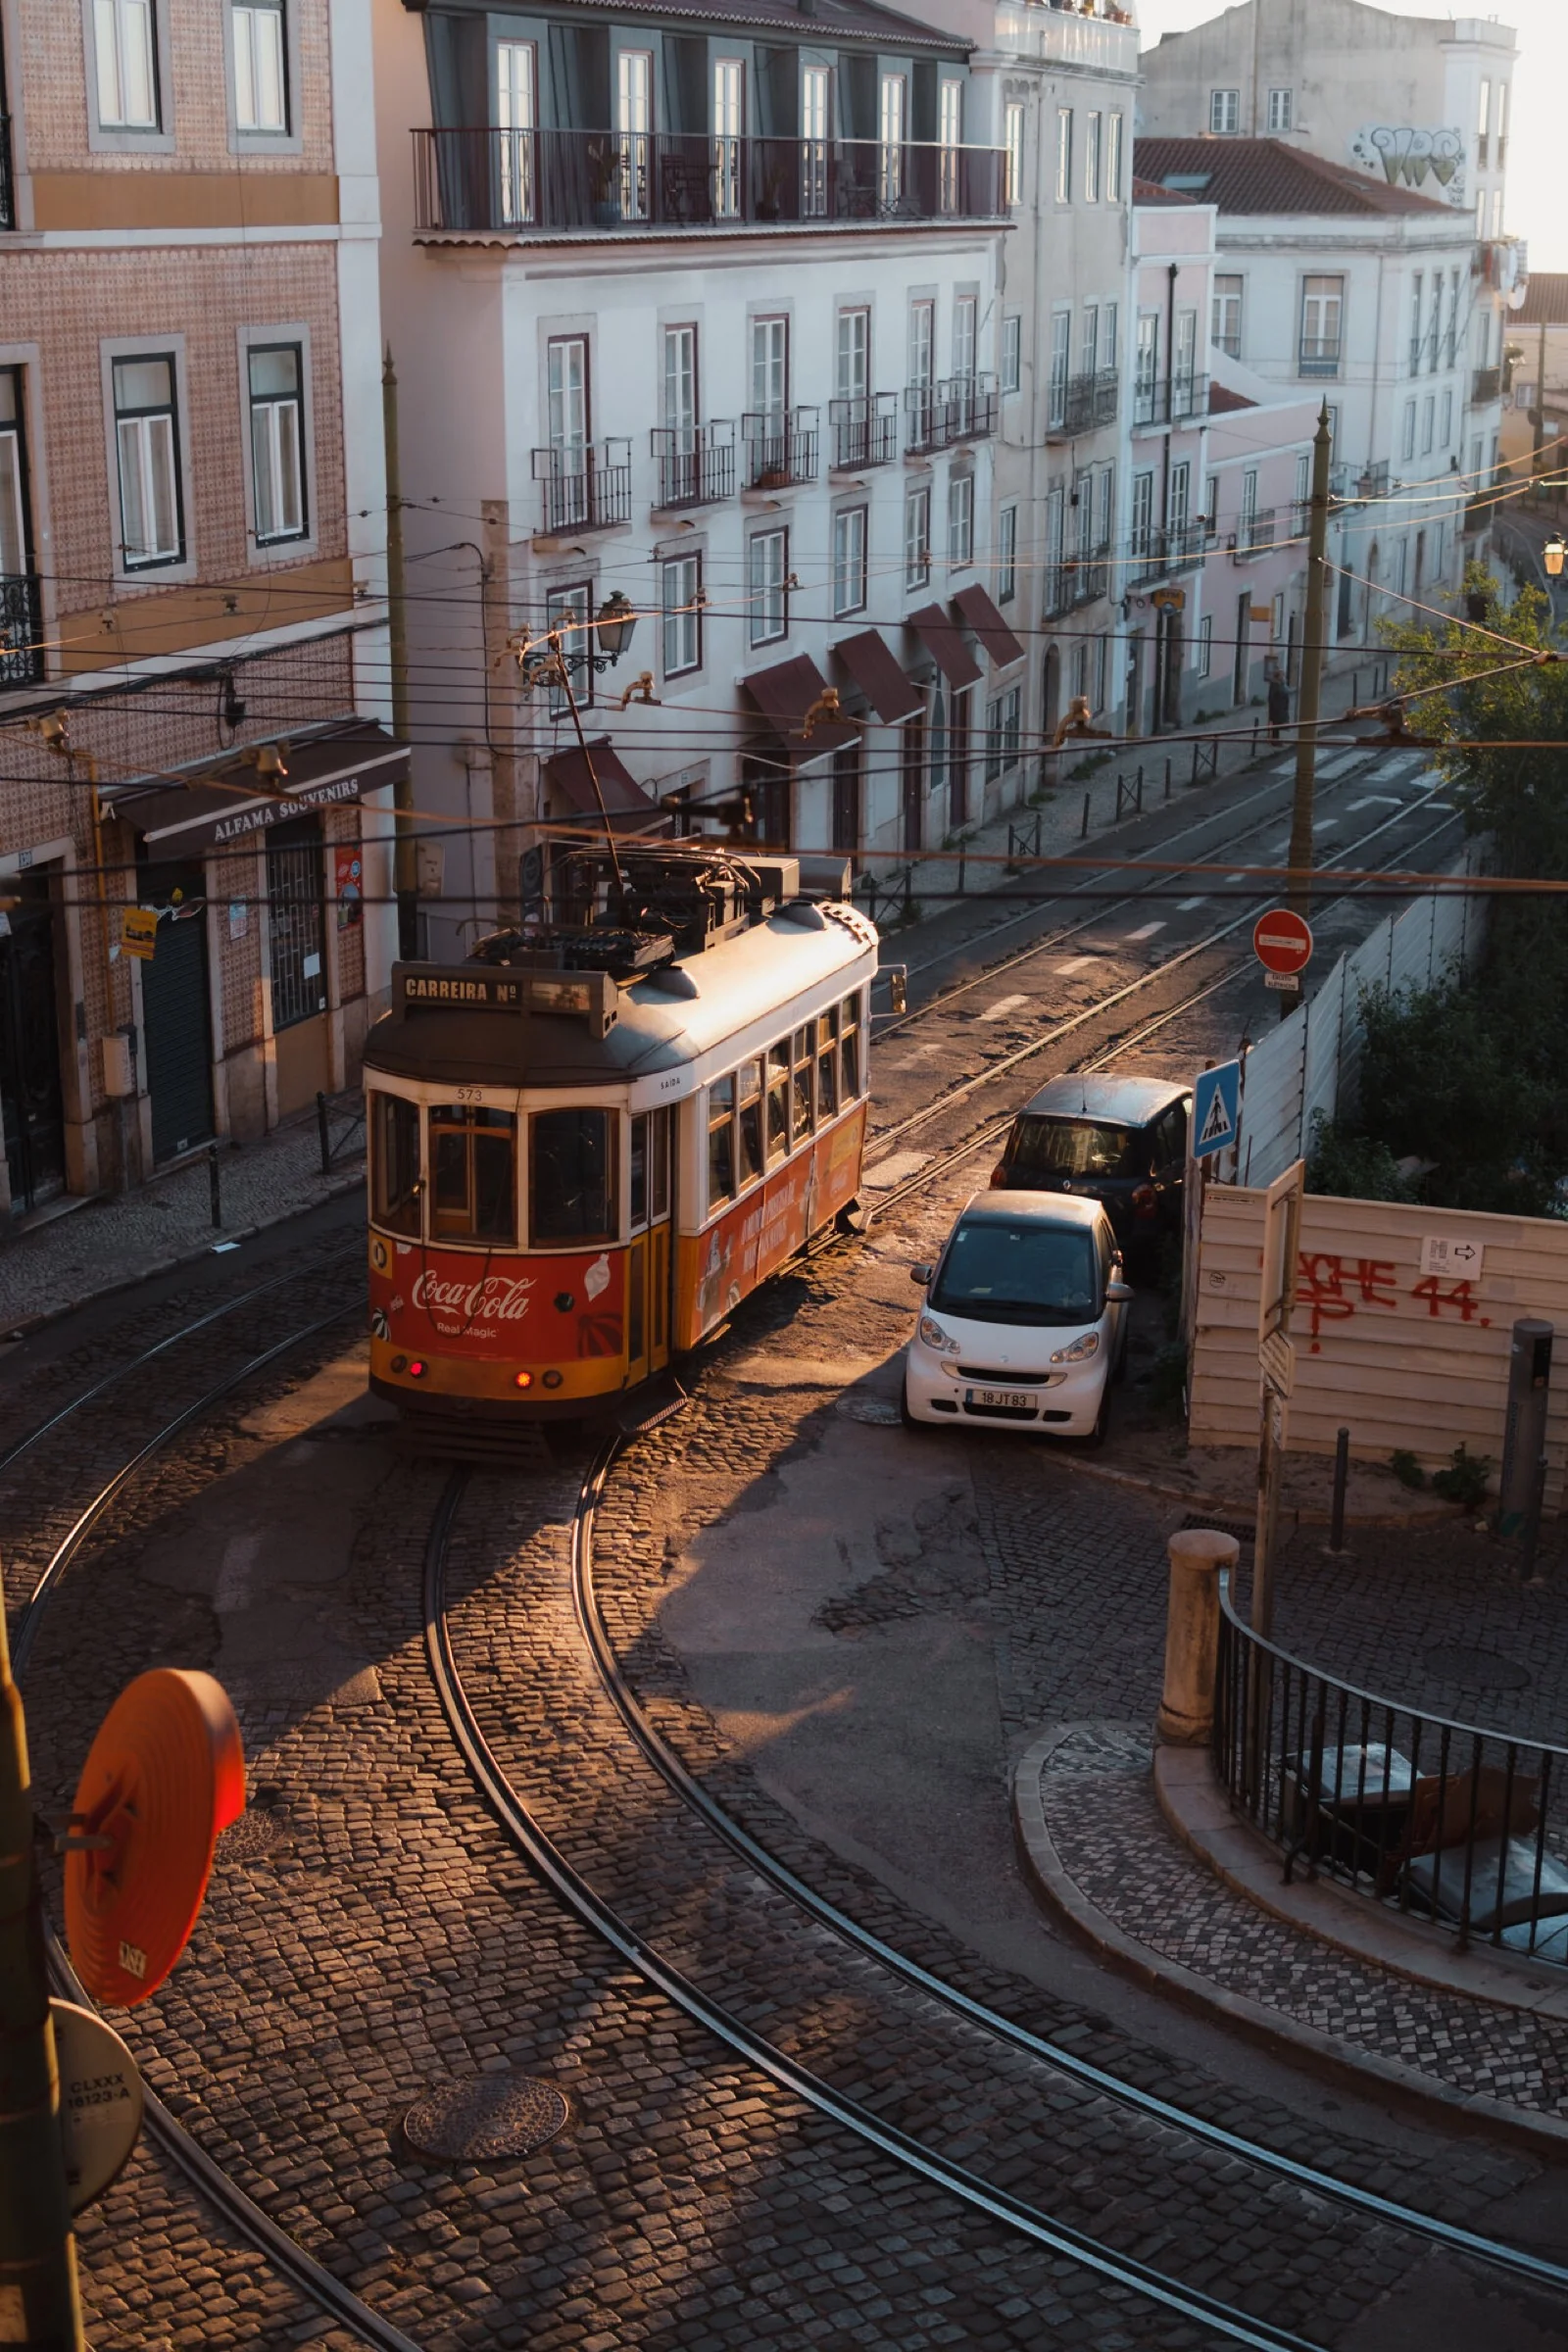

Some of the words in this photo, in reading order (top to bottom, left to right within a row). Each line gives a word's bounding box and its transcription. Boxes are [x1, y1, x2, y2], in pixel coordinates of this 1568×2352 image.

[215, 808, 275, 842] ALFAMA
[279, 778, 359, 818] SOUVENIRS
[406, 978, 487, 1001] CARREIRA
[496, 984, 516, 1002] Nº
[457, 1088, 482, 1102] 573
[412, 1269, 537, 1320] Coca-Cola
[437, 1322, 461, 1334] Real
[464, 1326, 497, 1339] Magic
[982, 1392, 995, 1403] 18
[996, 1393, 1010, 1405] JT
[1011, 1395, 1027, 1407] 83
[71, 2072, 124, 2094] CLXXX
